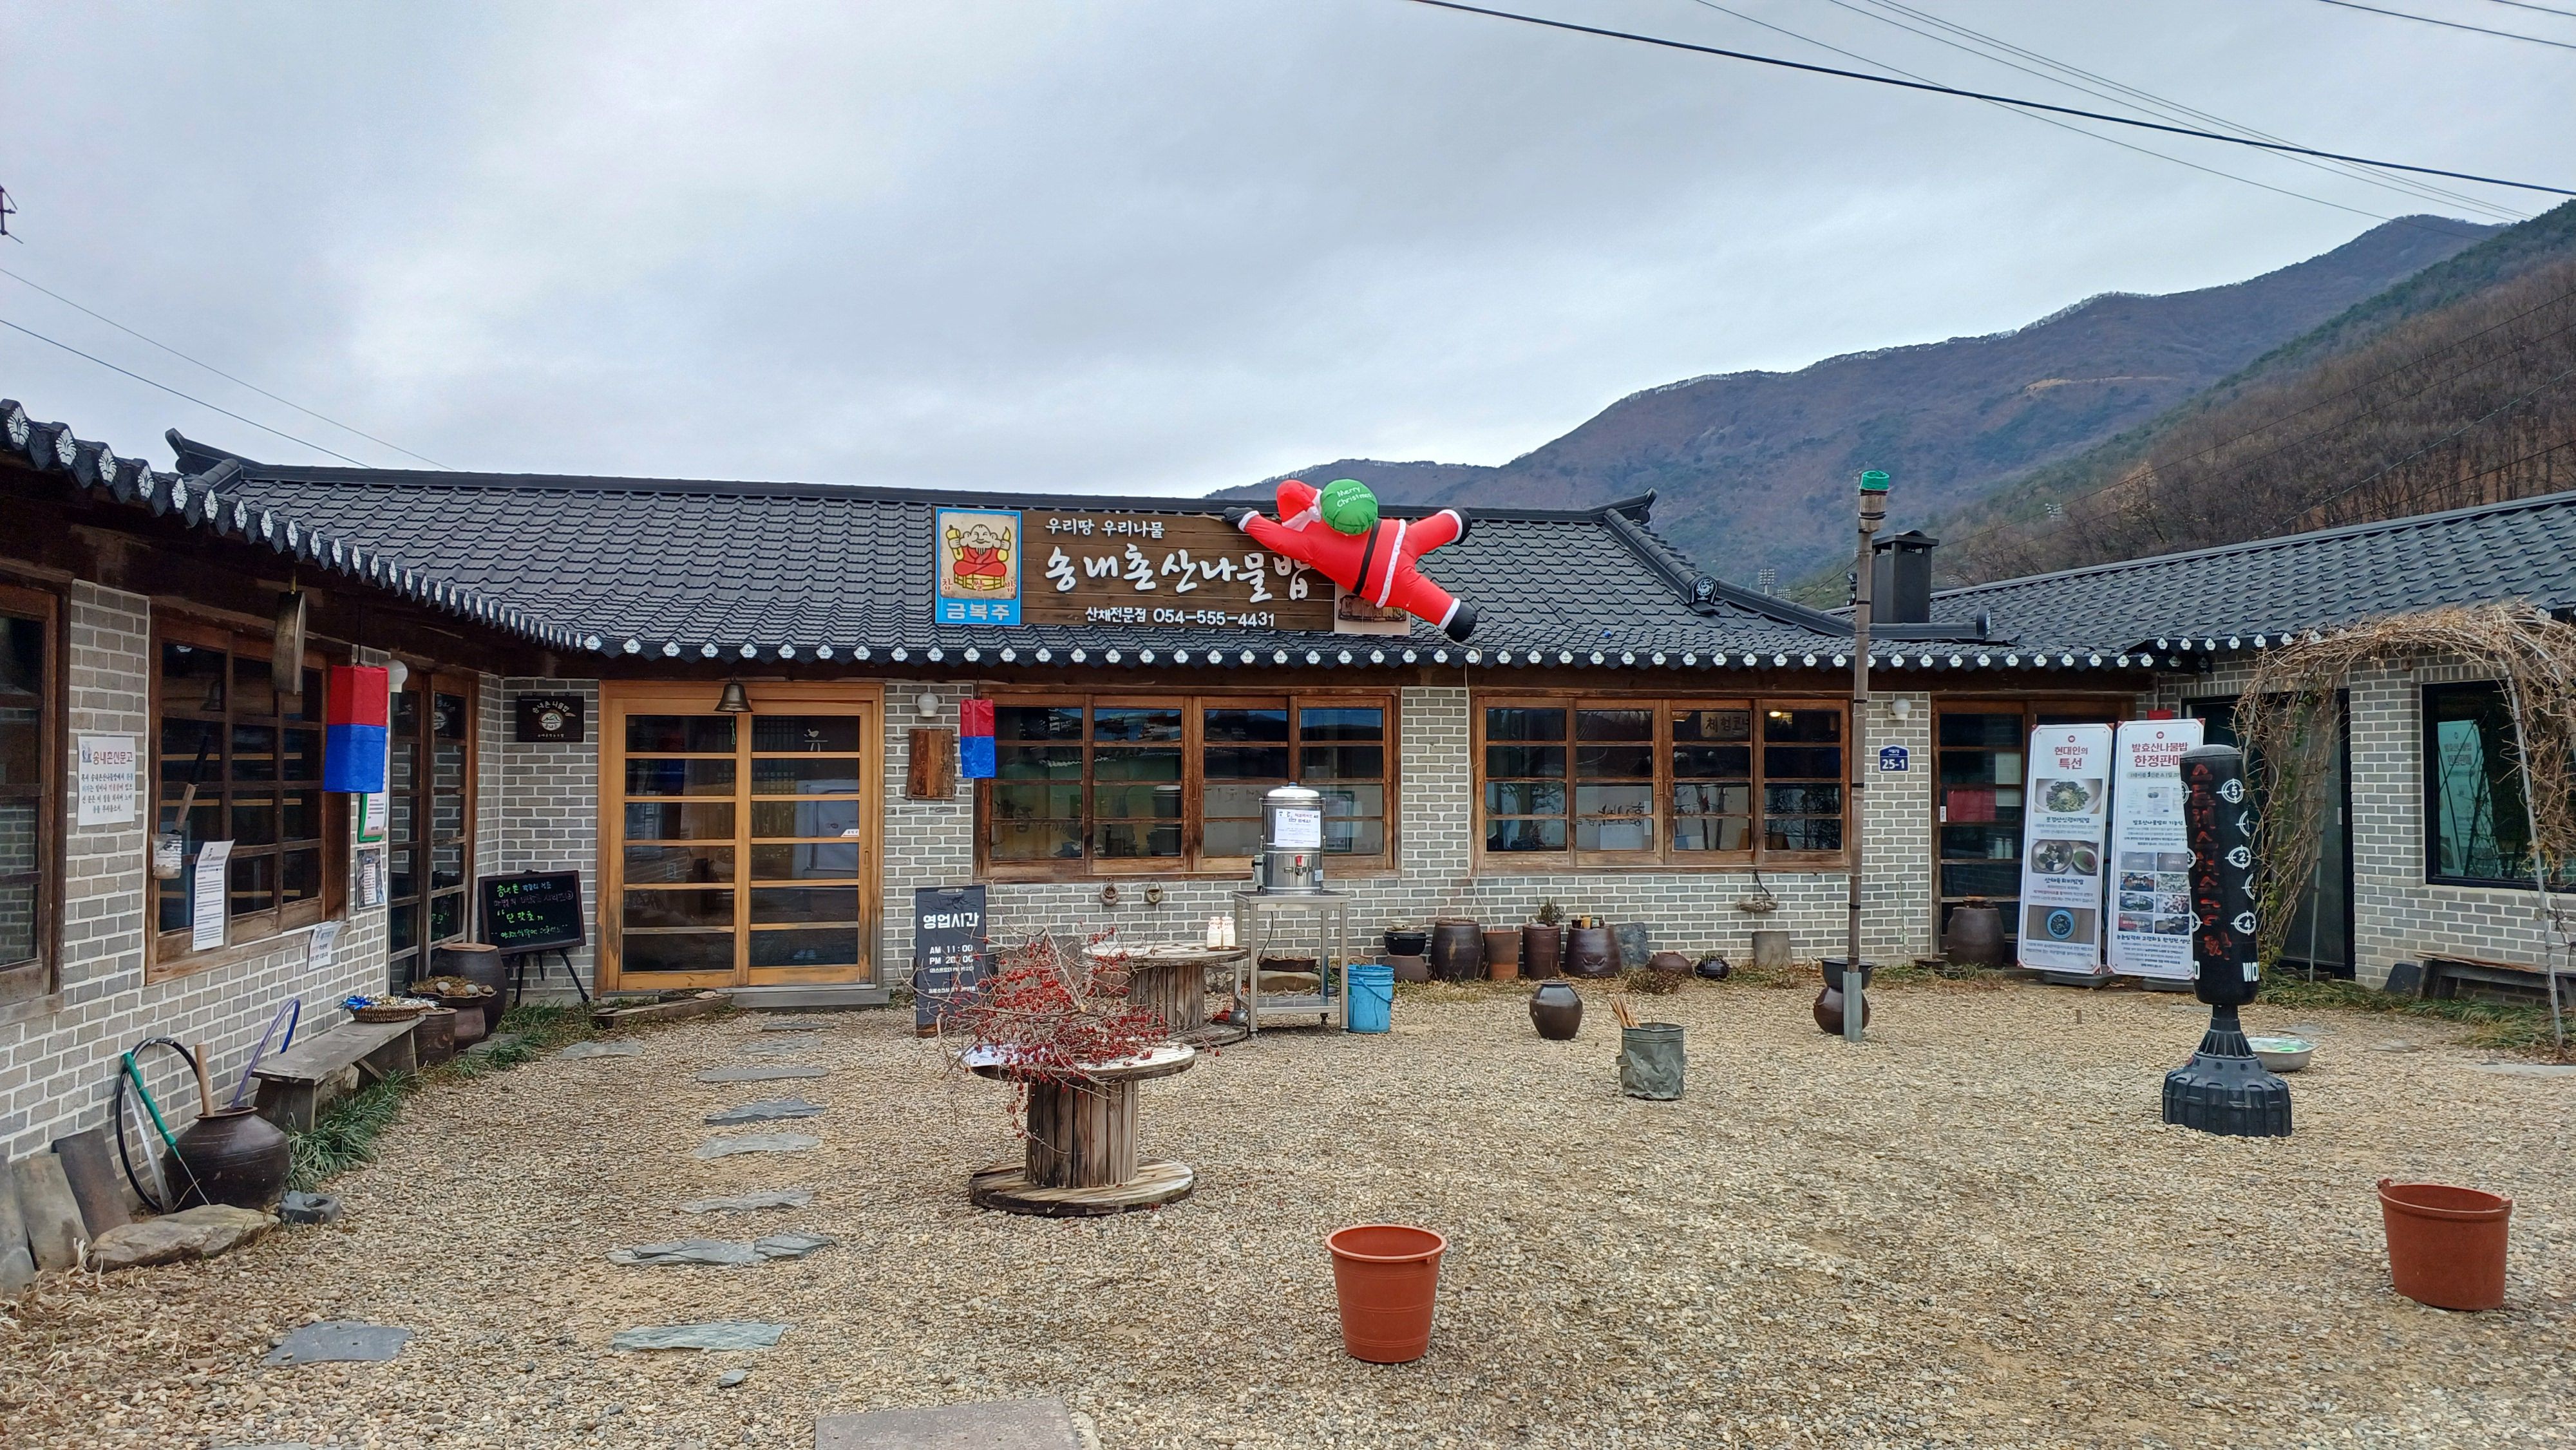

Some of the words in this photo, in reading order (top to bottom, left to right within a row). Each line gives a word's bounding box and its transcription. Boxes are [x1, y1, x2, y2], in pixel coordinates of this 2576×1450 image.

[1337, 487, 1360, 497] Merry
[1045, 518, 1094, 535] 우리땅
[1101, 520, 1165, 539] 우리나물
[947, 603, 1009, 621] 금복주
[1084, 607, 1146, 623] 산채전문점
[1153, 608, 1275, 627] 054-555-4431
[2054, 746, 2088, 756] 현대인의
[2132, 742, 2189, 753] 발효산나물밥
[1882, 759, 1904, 769] 25-1
[2058, 757, 2083, 769] 특선
[2232, 787, 2238, 796] 5
[2239, 852, 2246, 863] 2
[923, 912, 980, 929] 영업시간
[2244, 919, 2251, 928] 4
[947, 945, 972, 953] 11:00
[945, 956, 973, 964] 2000
[2242, 962, 2259, 982] WO
